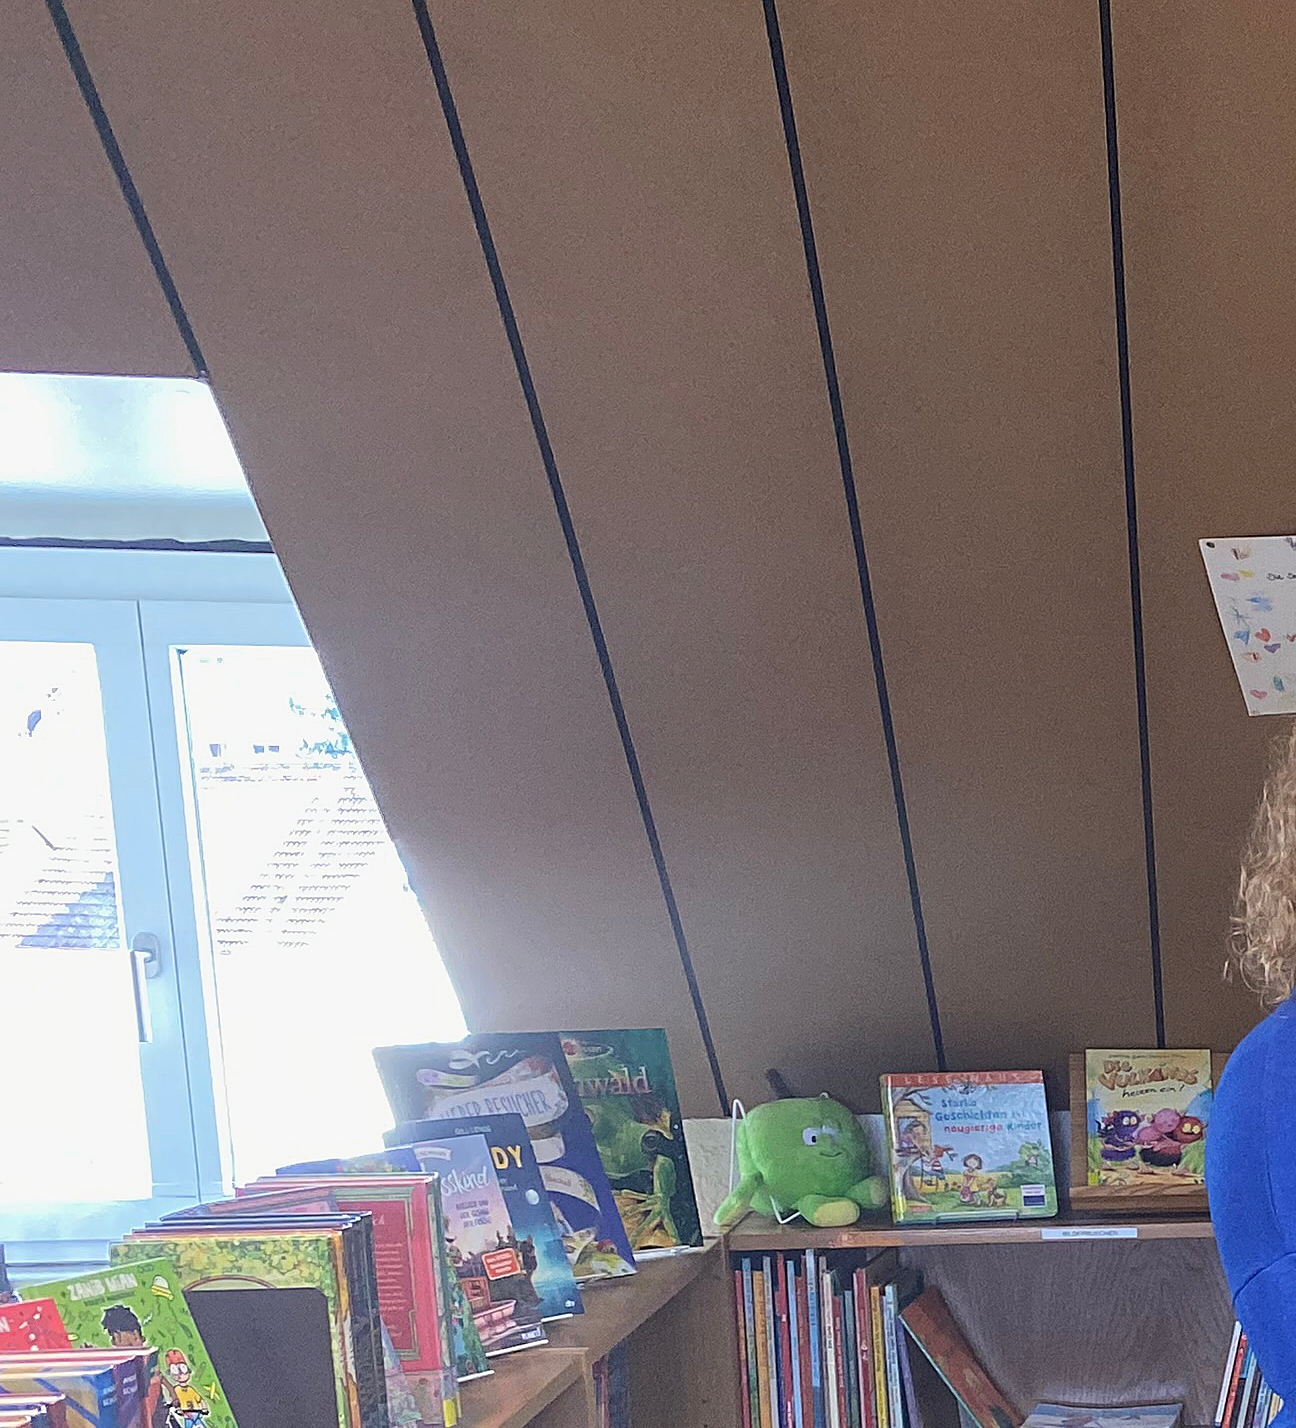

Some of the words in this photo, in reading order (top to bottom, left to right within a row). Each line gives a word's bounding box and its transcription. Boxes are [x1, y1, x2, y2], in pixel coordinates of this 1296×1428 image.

[935, 1110, 1008, 1121] Geschichten
[944, 1124, 1003, 1134] neugierige
[1007, 1122, 1042, 1131] Kinder
[490, 1145, 522, 1169] DY
[440, 1165, 489, 1197] sskind
